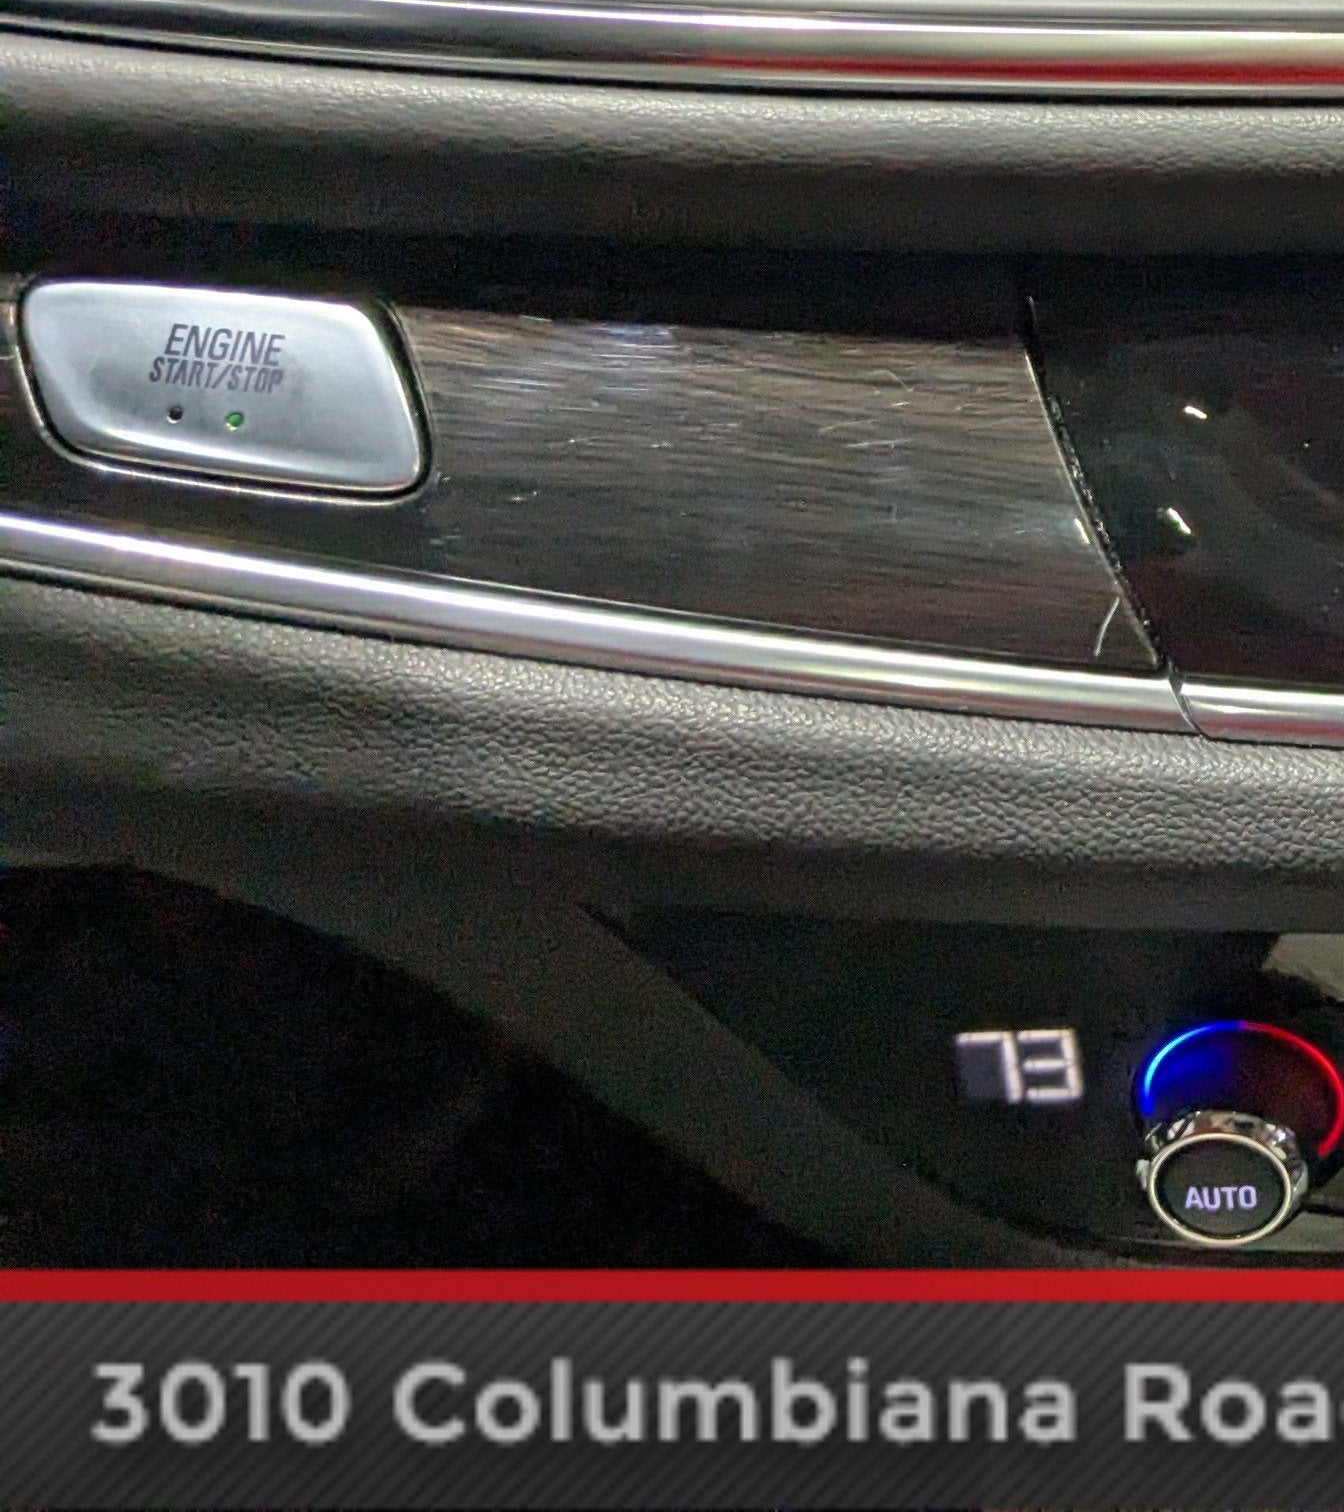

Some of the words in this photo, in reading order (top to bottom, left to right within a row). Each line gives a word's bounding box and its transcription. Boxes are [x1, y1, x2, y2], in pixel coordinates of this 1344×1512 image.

[163, 322, 287, 367] ENGINE
[148, 355, 284, 395] START/STOP
[955, 1027, 1084, 1104] 73
[1183, 1184, 1259, 1212] AUTO
